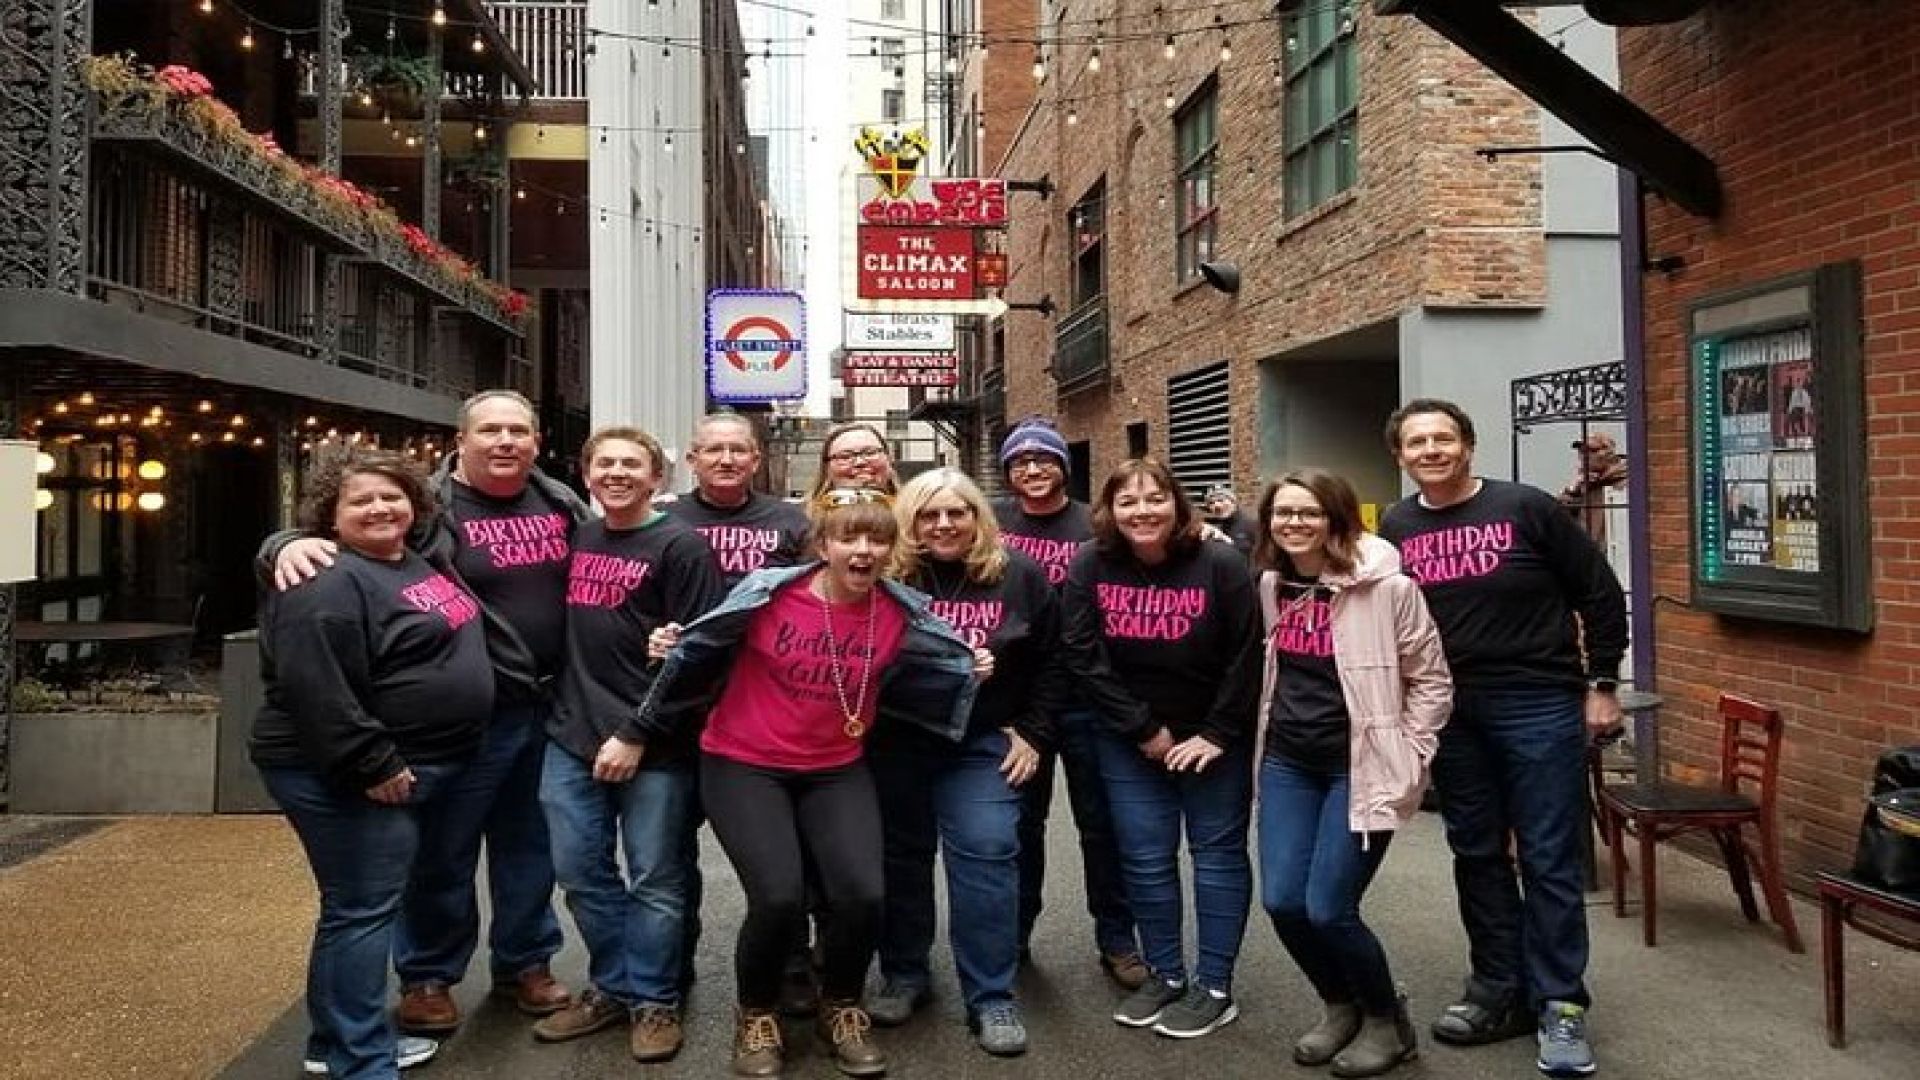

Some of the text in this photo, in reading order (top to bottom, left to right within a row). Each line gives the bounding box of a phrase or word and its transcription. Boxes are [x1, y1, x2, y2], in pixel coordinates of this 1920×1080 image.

[897, 237, 936, 250] THE
[864, 253, 968, 273] CLIMAX
[876, 277, 956, 290] SALOON
[1401, 521, 1512, 564] BIRTHDAY
[1412, 550, 1499, 585] SQUAD
[1097, 582, 1205, 618] BIRTHDAY
[1105, 611, 1191, 639] SQUAD
